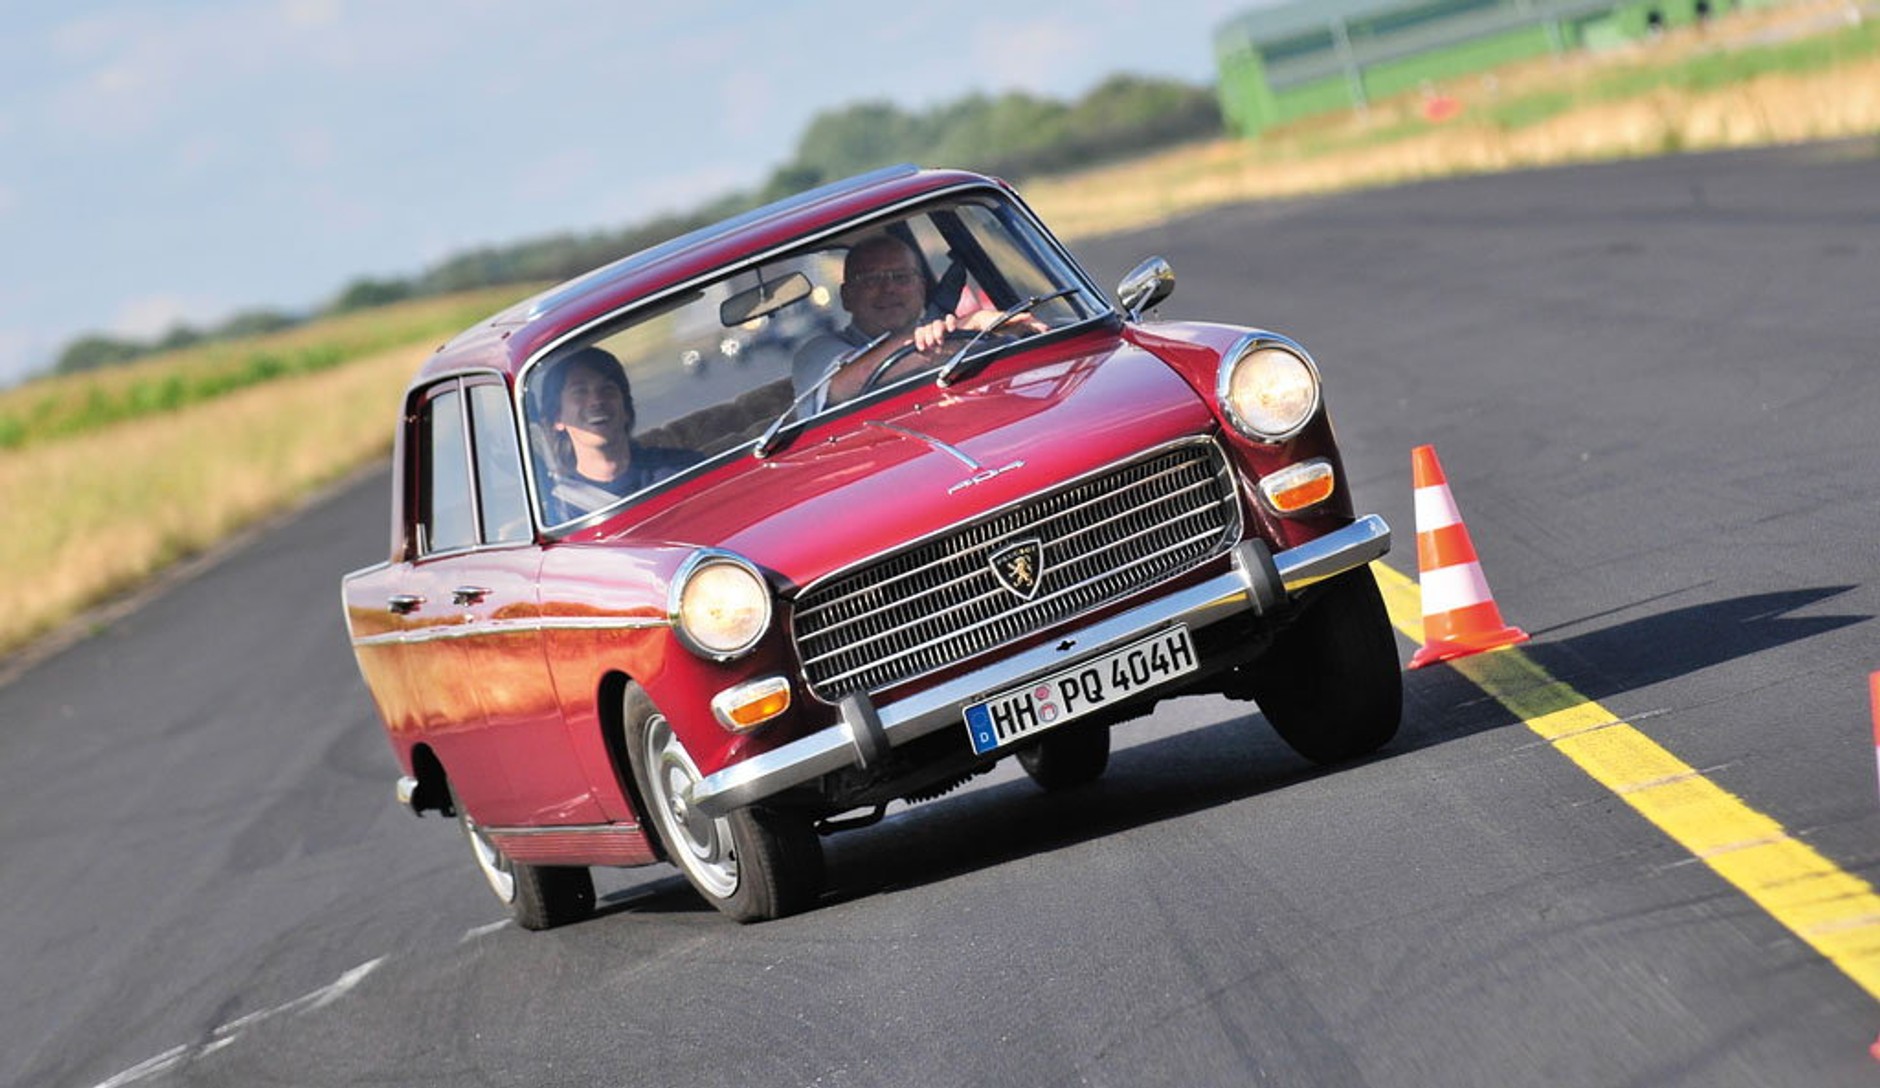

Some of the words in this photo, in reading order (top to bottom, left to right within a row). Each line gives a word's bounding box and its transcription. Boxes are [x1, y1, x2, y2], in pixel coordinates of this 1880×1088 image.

[991, 694, 1038, 738] HH
[1058, 670, 1104, 713] PQ
[1111, 633, 1193, 690] 404H
[980, 732, 989, 743] D
